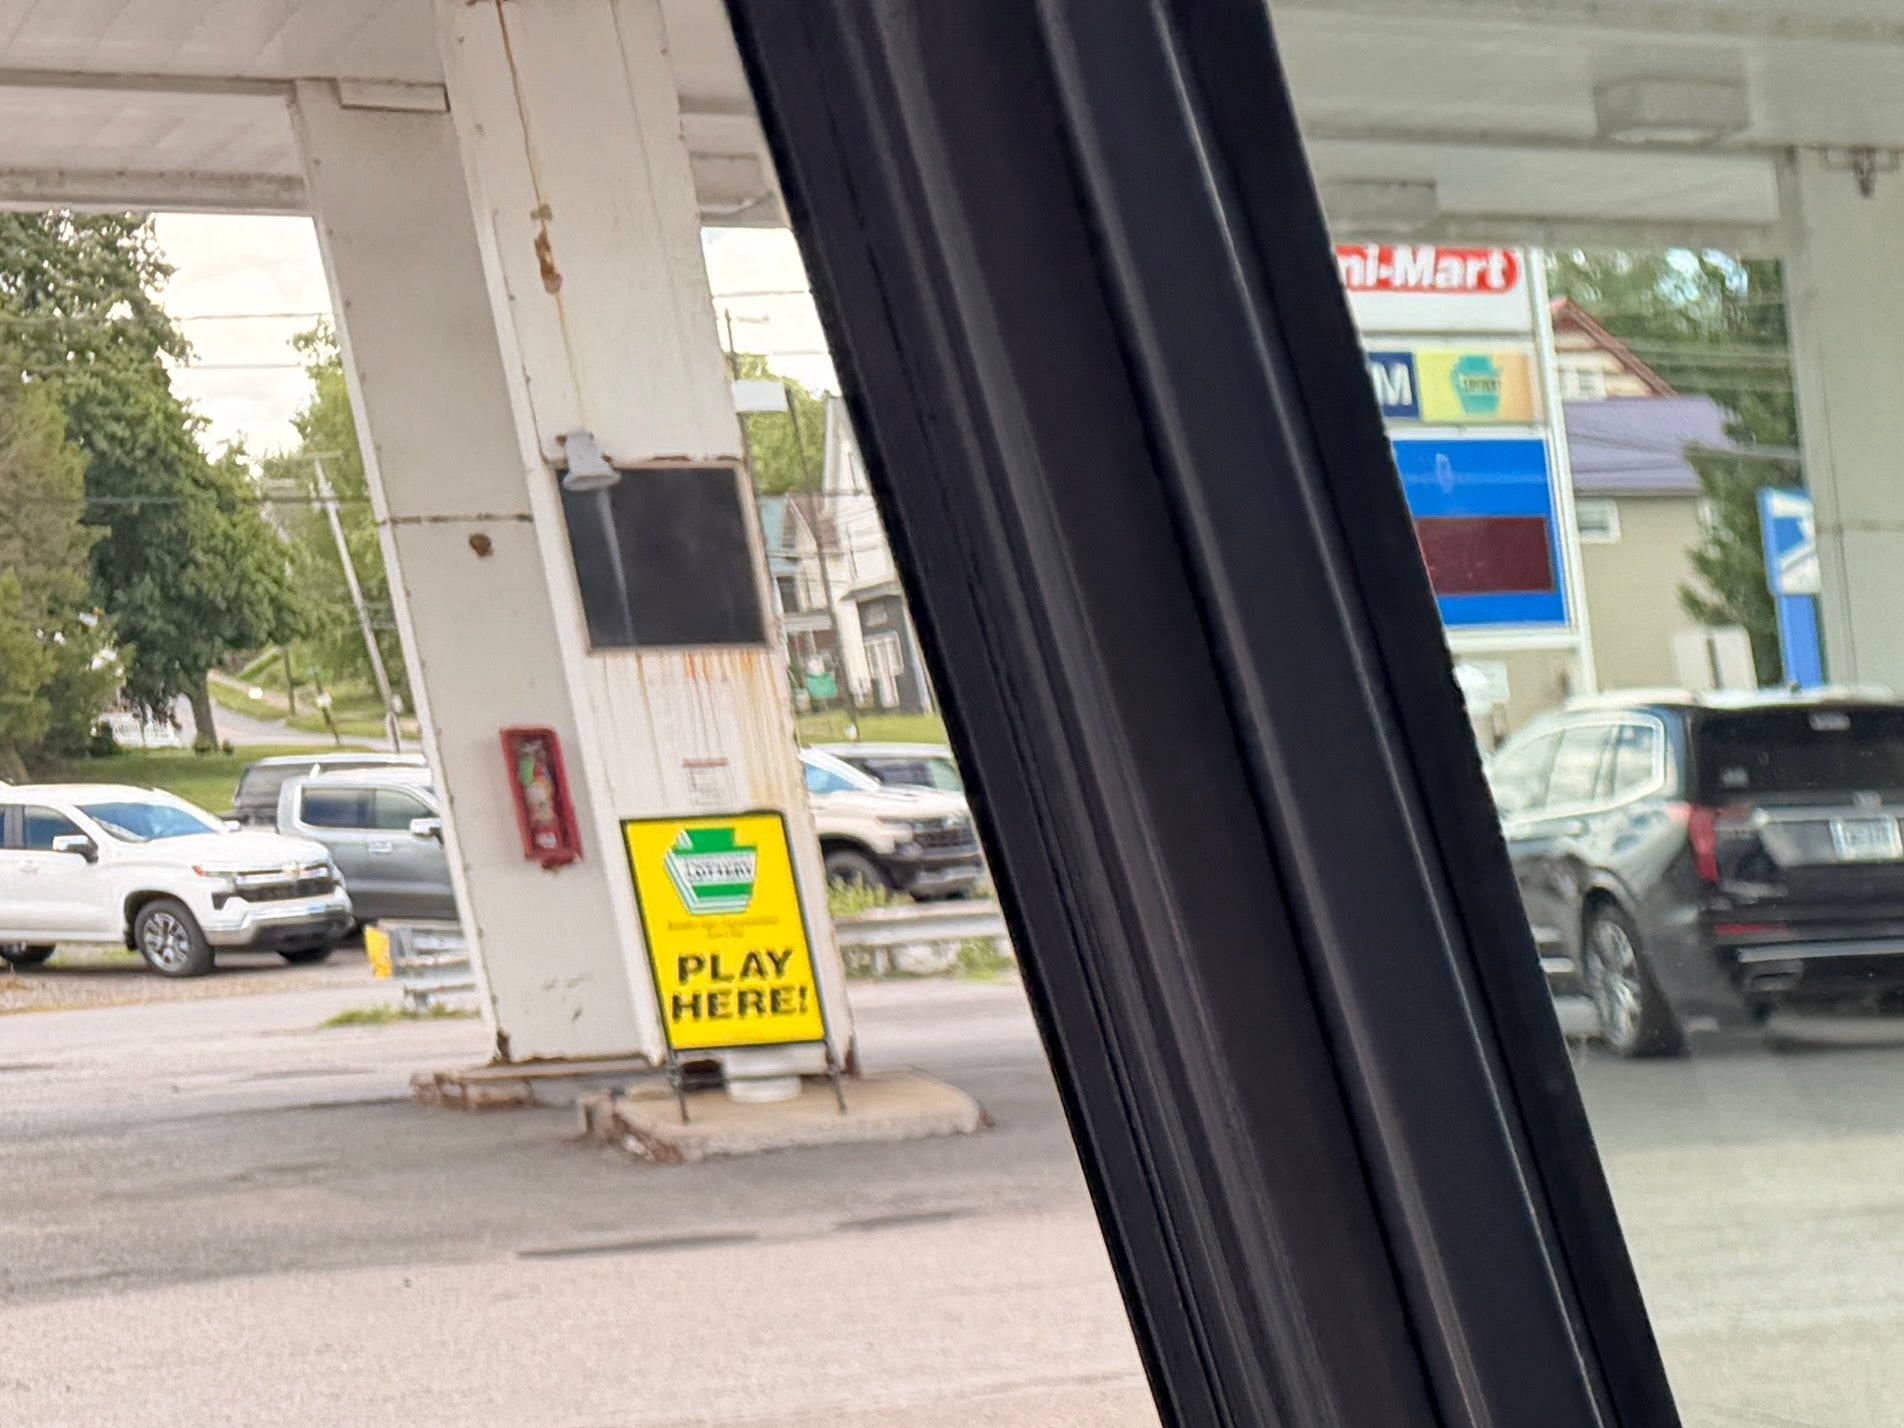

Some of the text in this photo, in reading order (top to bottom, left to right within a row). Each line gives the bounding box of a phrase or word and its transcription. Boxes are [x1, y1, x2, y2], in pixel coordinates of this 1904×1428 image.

[1340, 244, 1506, 289] ni-Mart
[677, 945, 794, 986] PLAY
[671, 986, 809, 1024] HERE!
